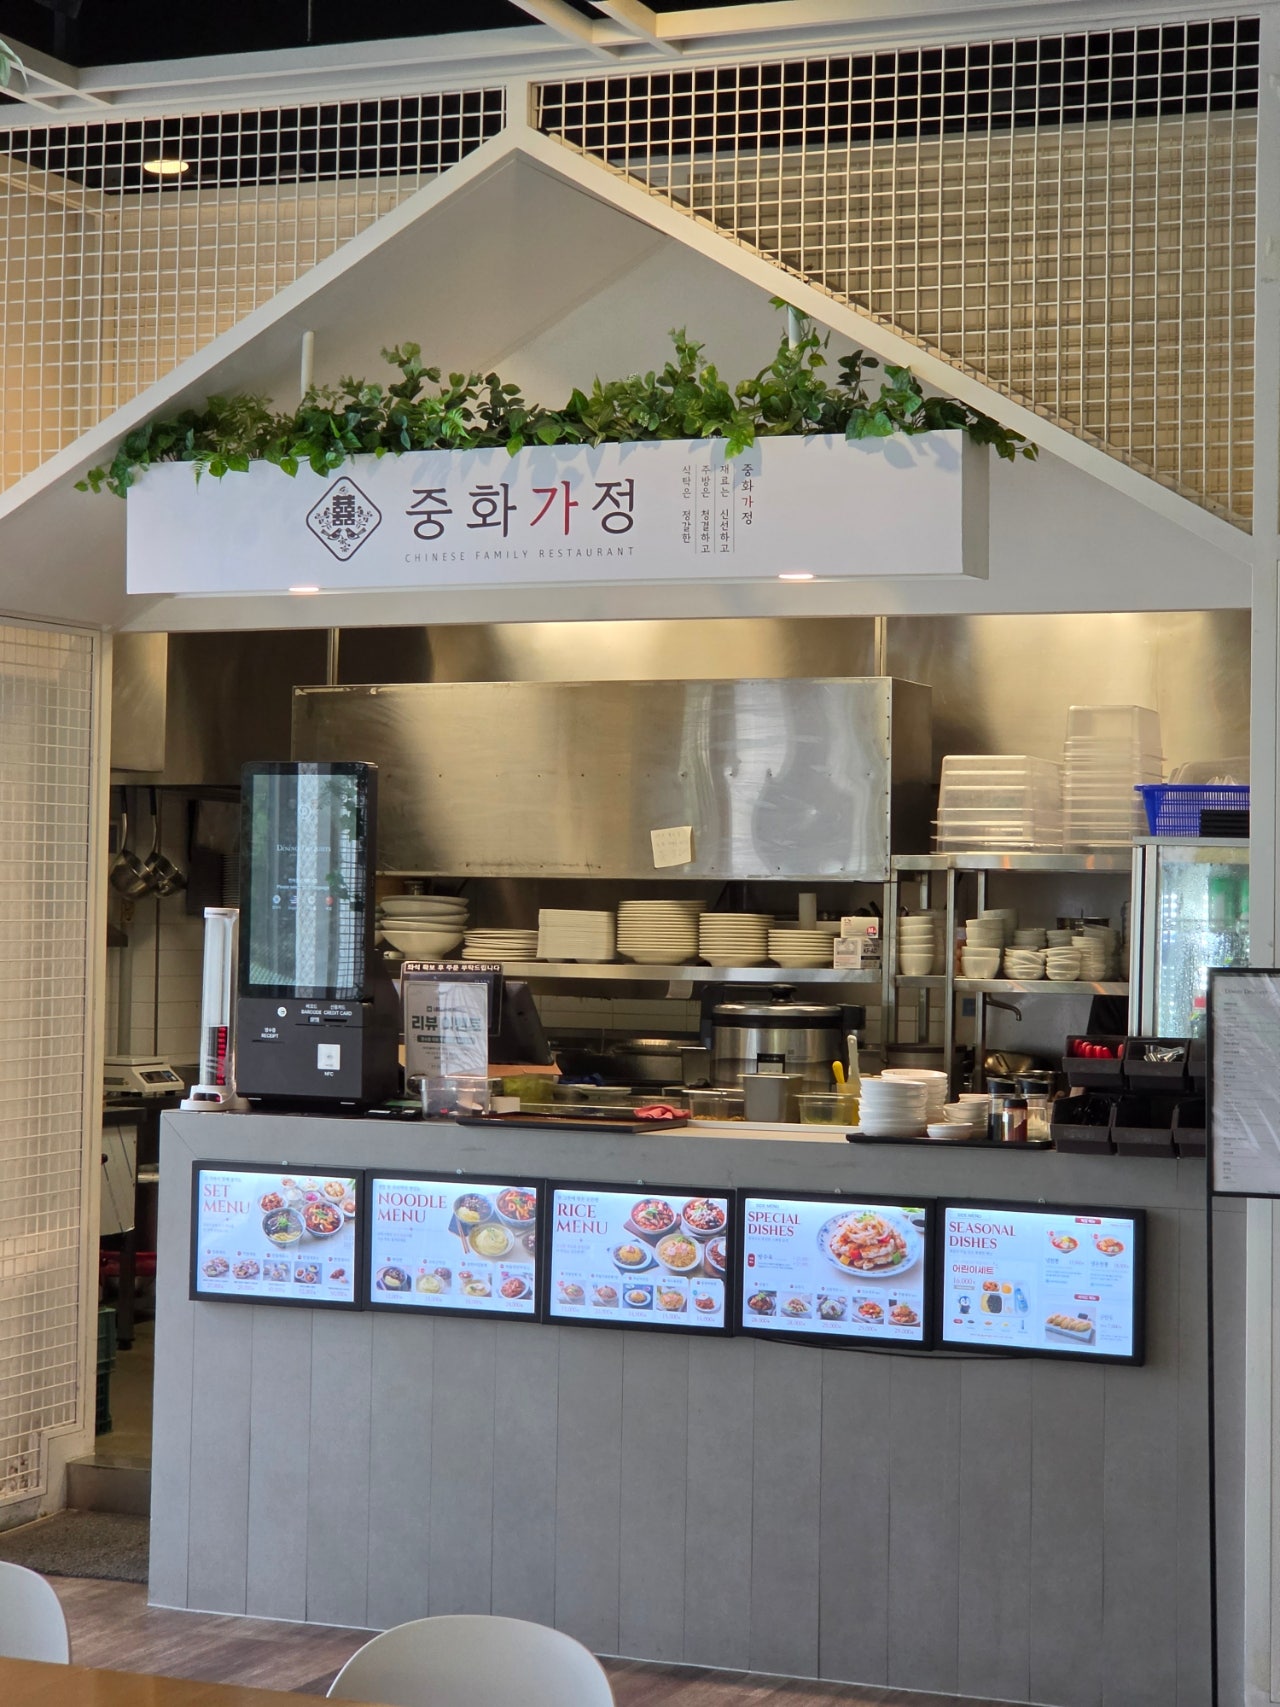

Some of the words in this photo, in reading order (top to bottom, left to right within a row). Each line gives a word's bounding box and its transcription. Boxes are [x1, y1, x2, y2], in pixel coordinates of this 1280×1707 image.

[682, 465, 692, 499] 식탁은
[701, 465, 711, 498] 주방은
[720, 464, 730, 498] 재료는
[741, 463, 754, 525] 중화가정
[405, 478, 635, 540] 중화가정
[682, 509, 692, 544] 정갈한
[701, 509, 711, 554] 청결하고
[720, 508, 730, 553] 신선하고
[405, 551, 465, 563] CHINESE
[476, 550, 529, 560] FAMILY
[539, 547, 635, 559] RESTAURANT
[411, 1015, 438, 1031] 리뷰
[440, 1015, 482, 1032] 이벤트
[204, 1184, 231, 1198] SET
[203, 1200, 250, 1214] MENU
[378, 1192, 447, 1209] NOODLE
[378, 1208, 426, 1223] MENU
[557, 1203, 596, 1218] RICE
[748, 1211, 800, 1225] SPECIAL
[556, 1219, 608, 1235] MENU
[748, 1223, 794, 1237] DISHES
[949, 1221, 1016, 1237] SEASONAL
[949, 1235, 997, 1249] DISHES
[952, 1264, 995, 1275] 어린이세트
